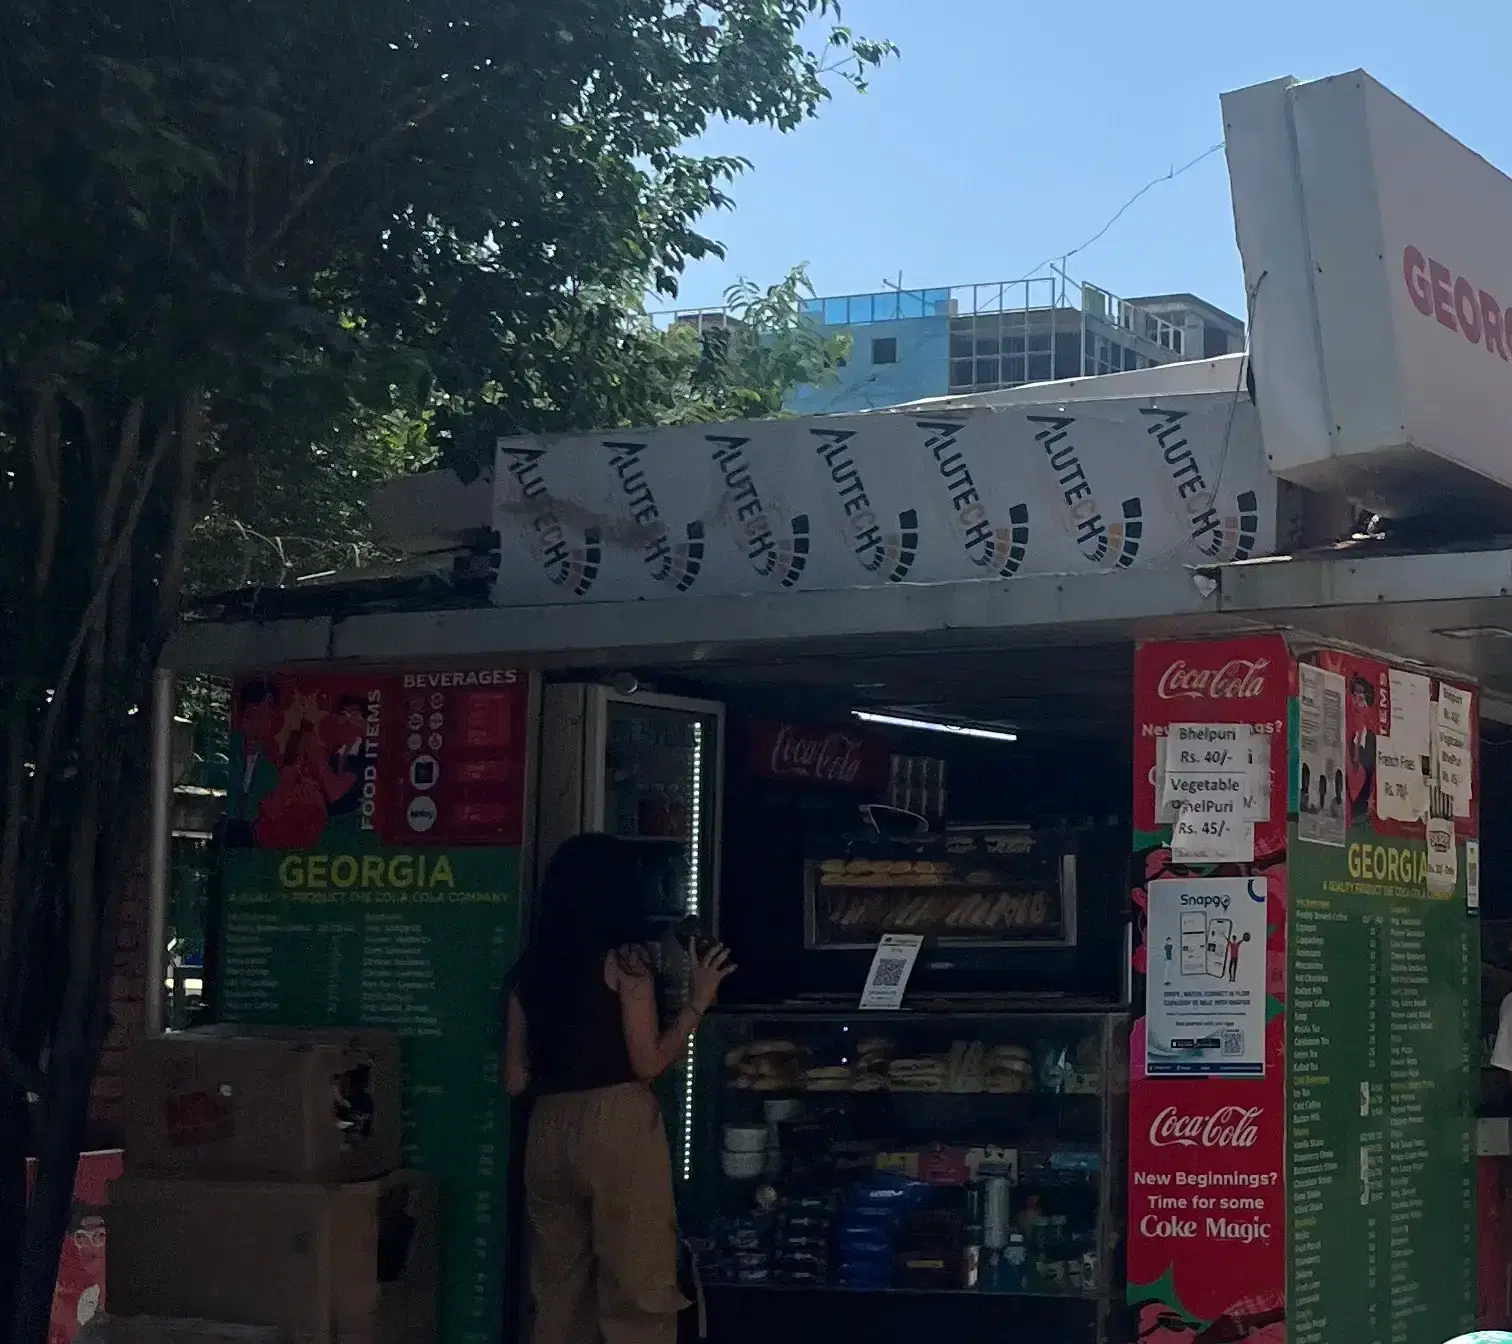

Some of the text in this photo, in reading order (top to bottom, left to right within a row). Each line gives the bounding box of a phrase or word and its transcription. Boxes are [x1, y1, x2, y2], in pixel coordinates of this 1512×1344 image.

[502, 447, 570, 569] ALUECH
[603, 441, 672, 564] ALUTEH
[403, 669, 518, 689] BEVERAGES
[1179, 728, 1236, 742] Bhelpuri
[360, 689, 381, 831] FOOD ITEMS
[1180, 750, 1233, 766] Rs. 40/-
[1171, 777, 1240, 794] Vegetable
[1179, 821, 1231, 836] Rs. 45/-
[278, 854, 455, 889] GEORGIA
[1347, 843, 1428, 883] GEORGIA
[1134, 1171, 1278, 1188] New Beginnings?
[1147, 1195, 1265, 1209] Time for some
[1140, 1215, 1272, 1244] Coke Magic
